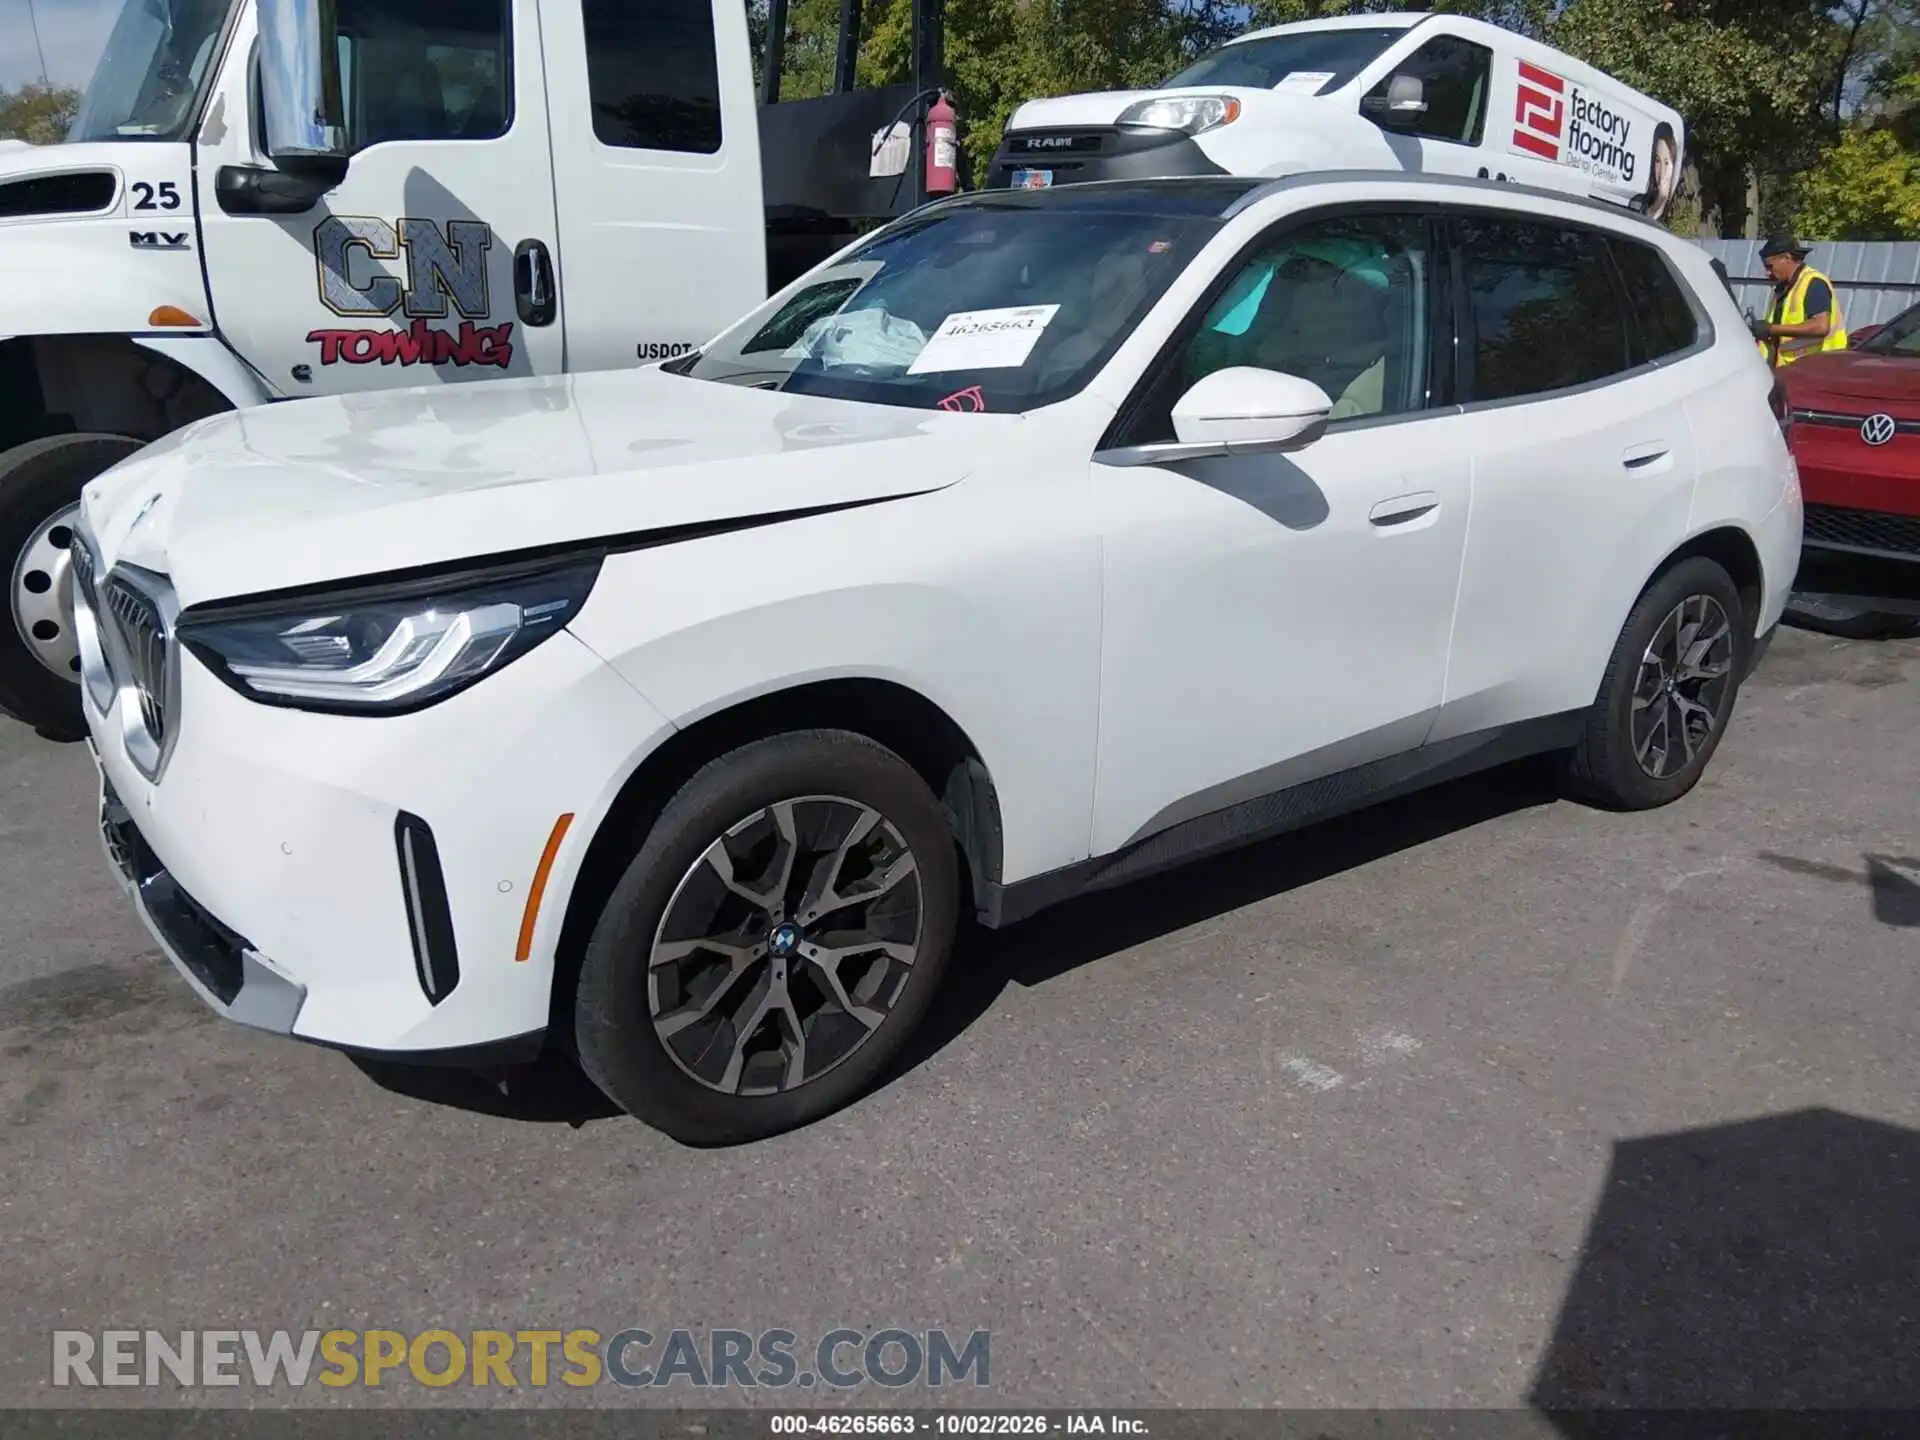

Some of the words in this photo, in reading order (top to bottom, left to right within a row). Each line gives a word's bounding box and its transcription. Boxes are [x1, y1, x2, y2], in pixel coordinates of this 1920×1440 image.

[1570, 87, 1631, 147] factory
[1027, 136, 1073, 149] RAM
[1567, 119, 1636, 183] flooring
[131, 181, 182, 210] 25
[128, 231, 190, 249] MV
[313, 214, 493, 320] CN
[305, 317, 514, 369] TOWING
[637, 342, 693, 360] USDOT
